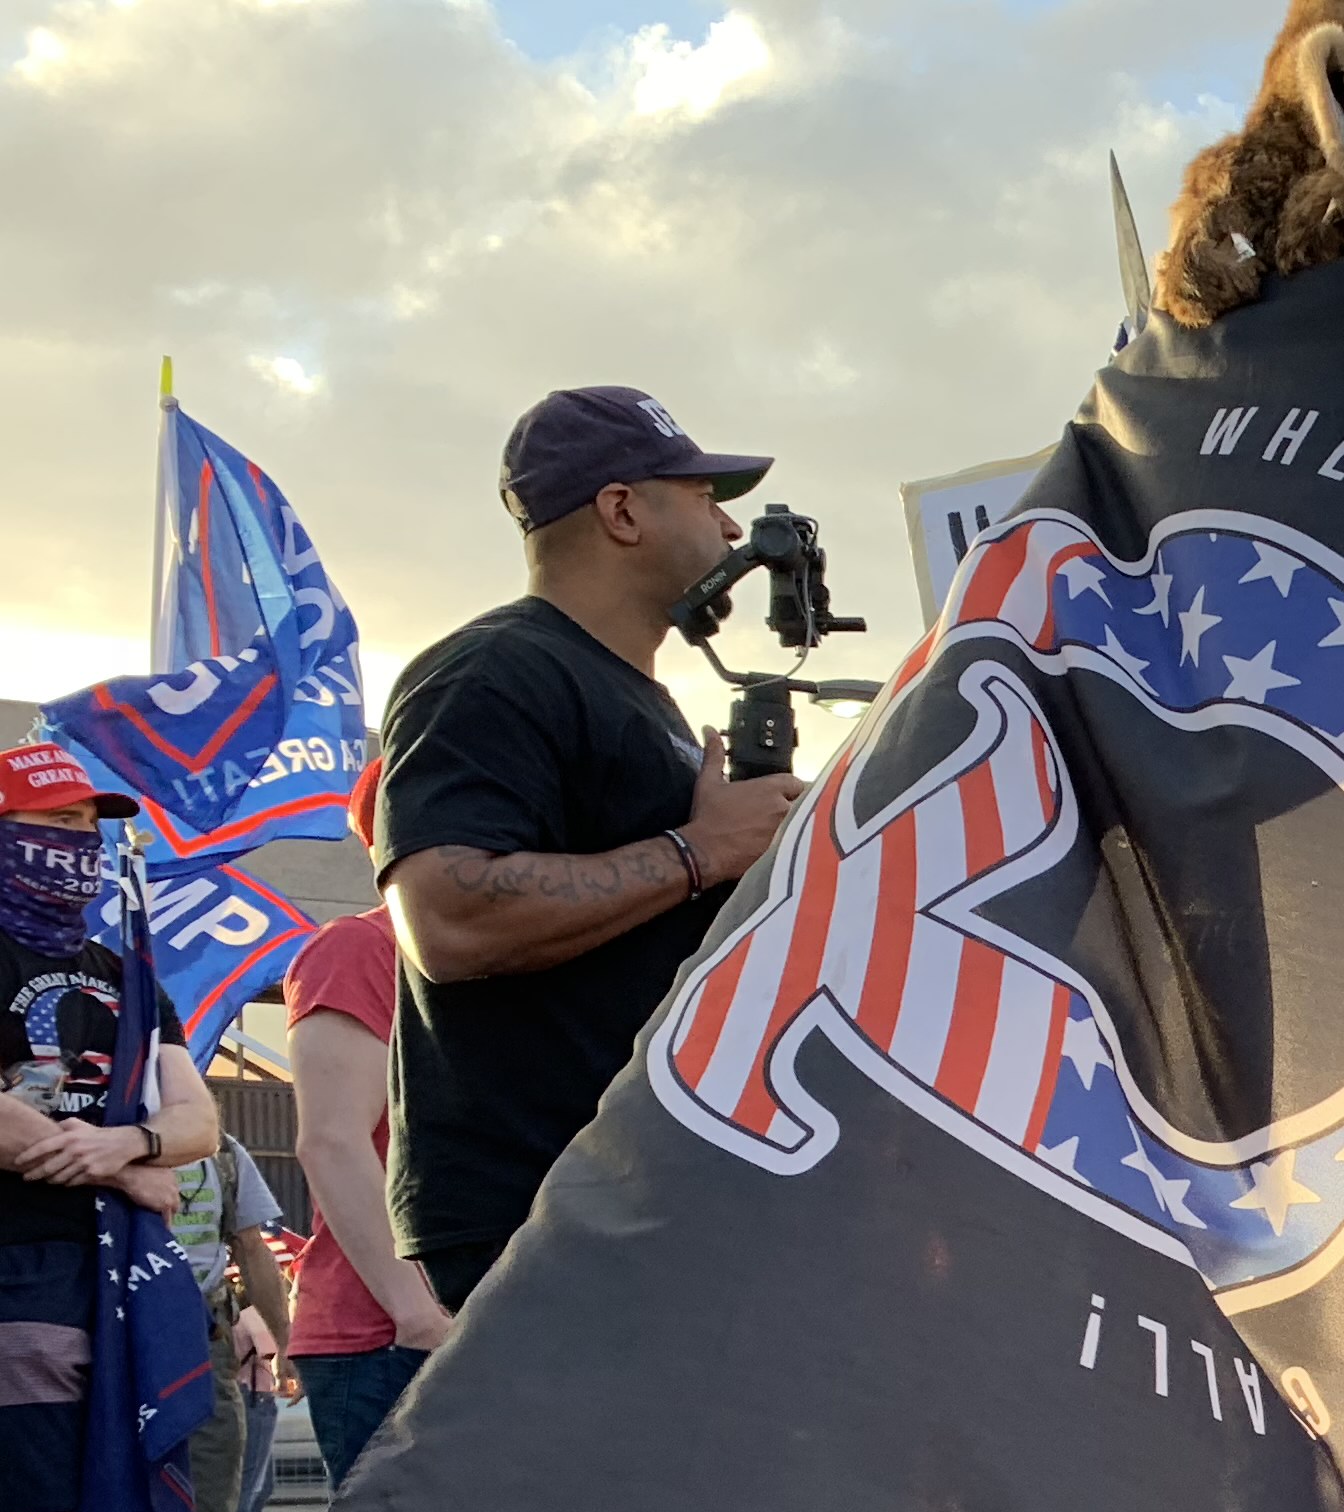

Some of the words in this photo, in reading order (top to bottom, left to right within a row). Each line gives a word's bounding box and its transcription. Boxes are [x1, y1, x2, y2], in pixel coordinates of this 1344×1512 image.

[636, 399, 686, 438] JE
[701, 568, 728, 595] RONIN
[7, 750, 53, 772] MAKE
[28, 767, 76, 788] GREAT
[16, 839, 101, 878] TRU
[9, 985, 36, 1015] THE
[28, 972, 68, 993] GREAT
[1079, 1293, 1266, 1436] ALL!
